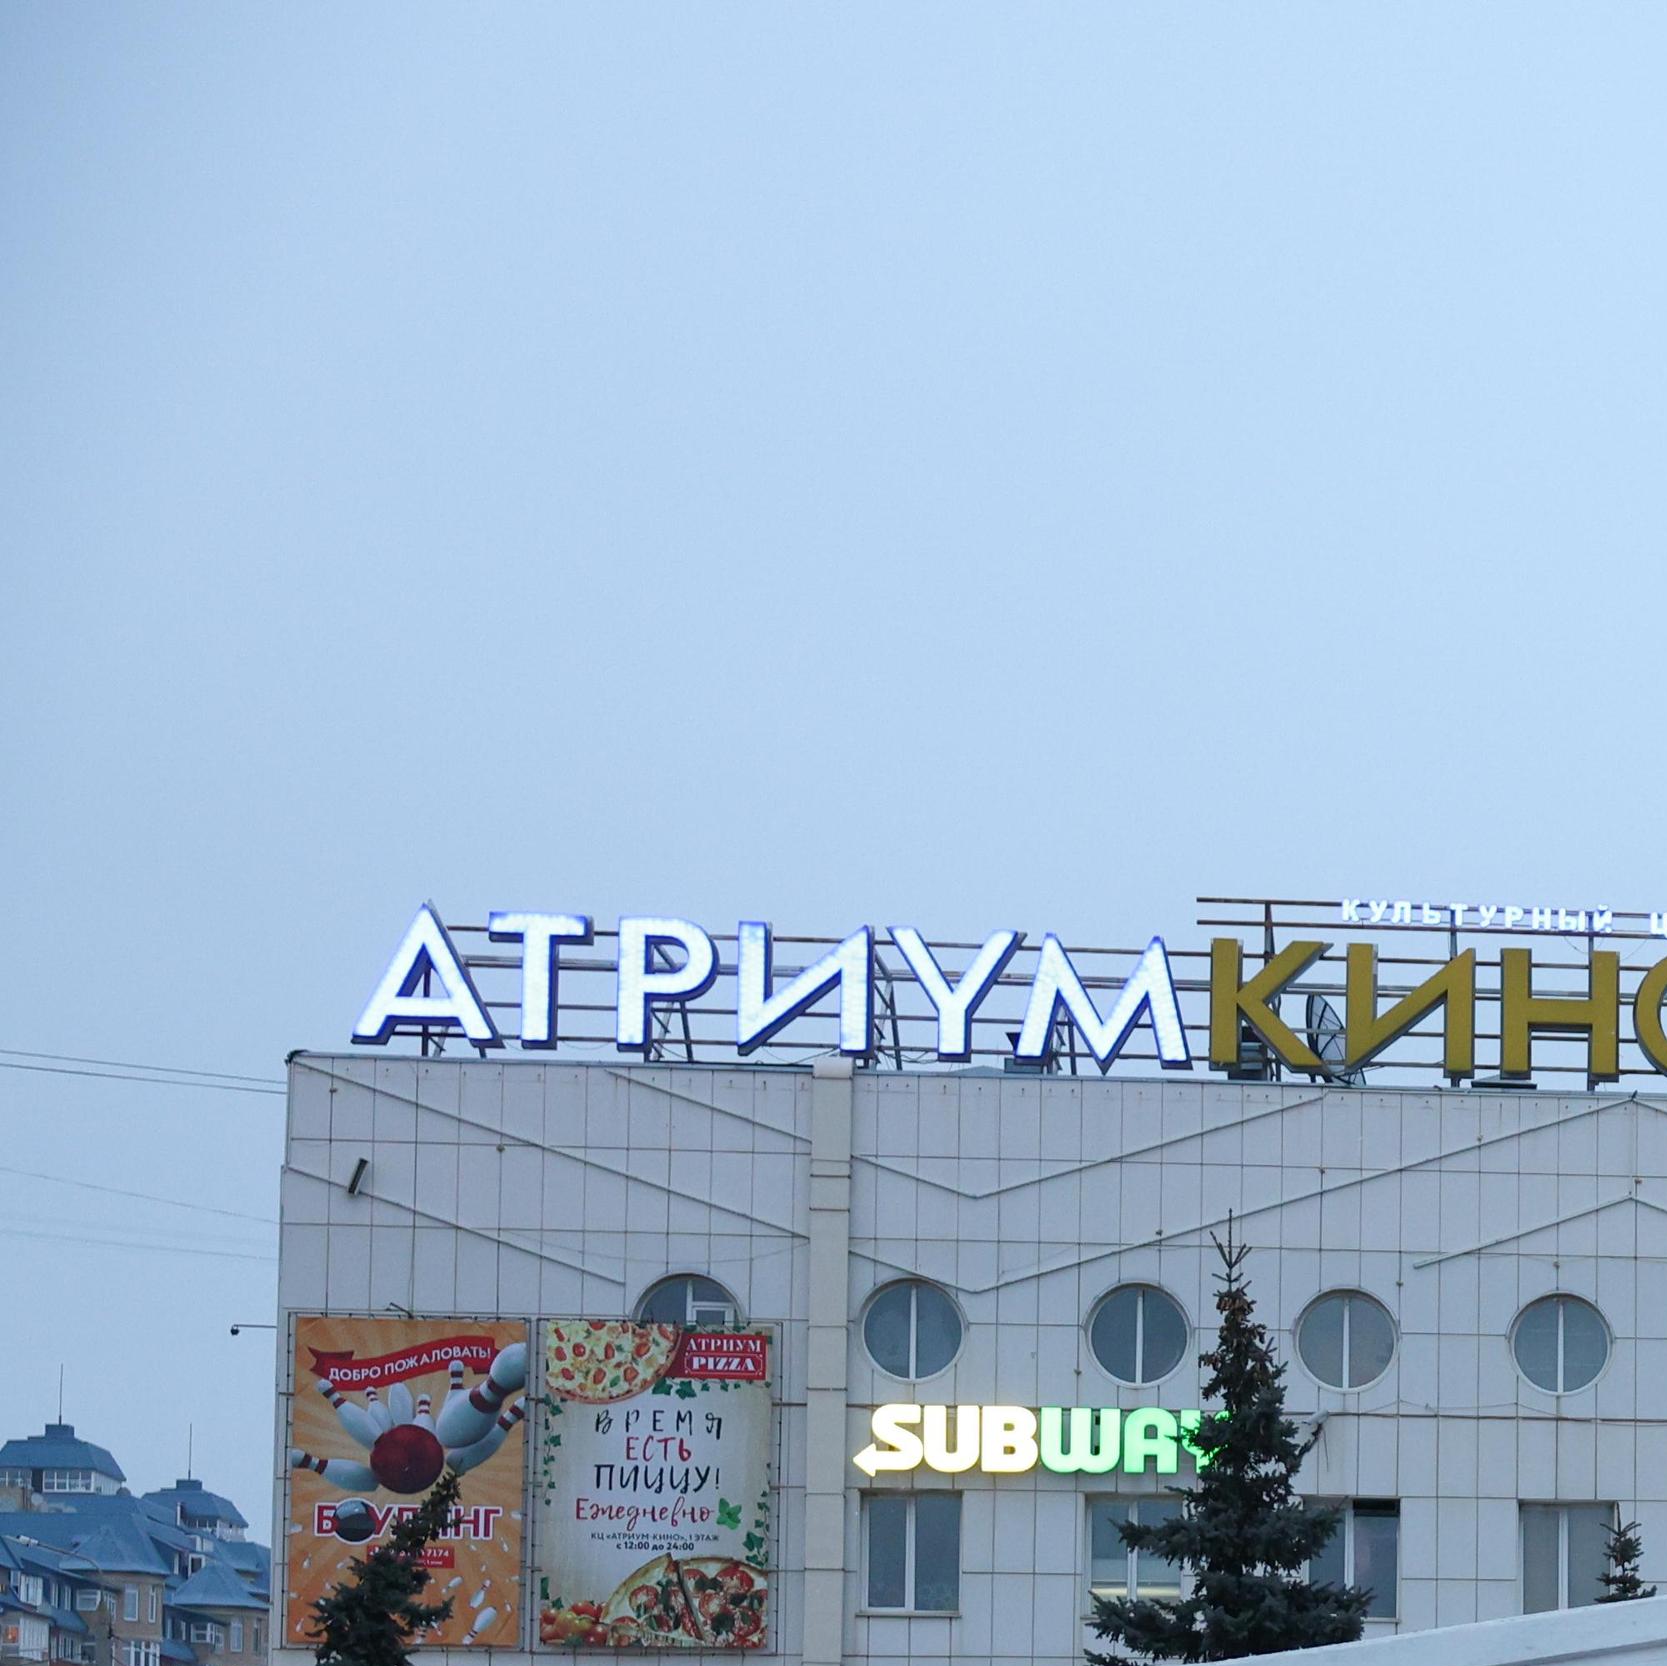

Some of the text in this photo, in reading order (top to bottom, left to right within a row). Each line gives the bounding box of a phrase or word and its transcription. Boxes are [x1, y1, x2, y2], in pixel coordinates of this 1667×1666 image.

[1341, 898, 1613, 934] КУЛЬТУРНЫЙ
[351, 900, 1192, 1074] АТРИУМ
[686, 1338, 762, 1353] АТРИУМ
[328, 1346, 492, 1382] ДОБРО ПОЖАЛОВАТЬ!
[691, 1355, 756, 1372] PIZZA
[594, 1408, 723, 1440] ВРЕМЯ
[625, 1434, 693, 1462] ЕСТЬ
[594, 1463, 721, 1494] ПИЦЦУ!
[314, 1497, 503, 1545] БОУНГ
[575, 1495, 715, 1532] Ежедневно
[623, 1541, 650, 1550] 12:00
[651, 1543, 665, 1551] до
[665, 1542, 695, 1551] 24:00
